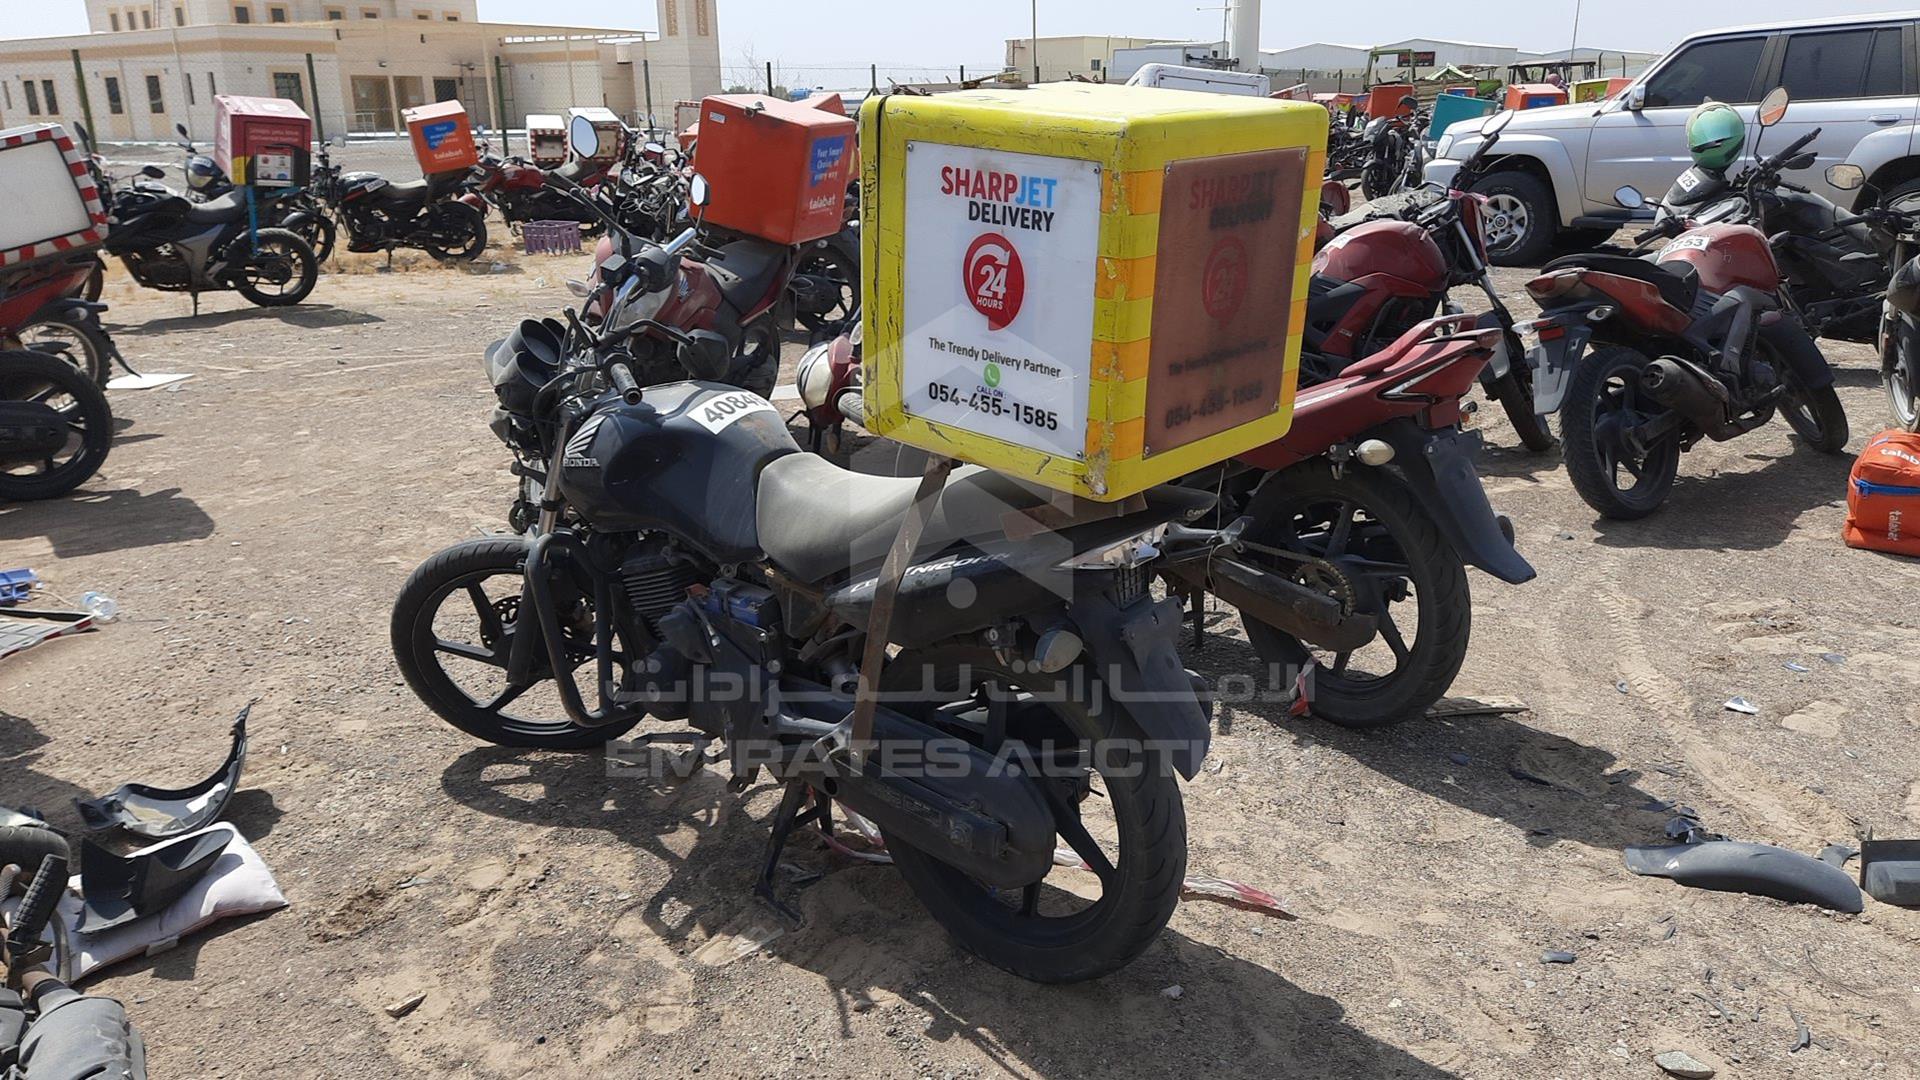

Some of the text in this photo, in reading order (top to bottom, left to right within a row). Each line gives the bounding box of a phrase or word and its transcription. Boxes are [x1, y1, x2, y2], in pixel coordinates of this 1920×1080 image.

[941, 166, 1057, 208] SHARPJET
[969, 200, 1055, 232] DELIVERY
[978, 265, 1007, 300] 24
[976, 296, 1003, 310] HOURS
[929, 337, 1061, 378] The Trendy Delivery Partner
[928, 382, 1058, 431] 054-455-1585
[976, 385, 992, 396] CALL
[563, 458, 600, 467] HONDA
[1880, 449, 1920, 465] talab
